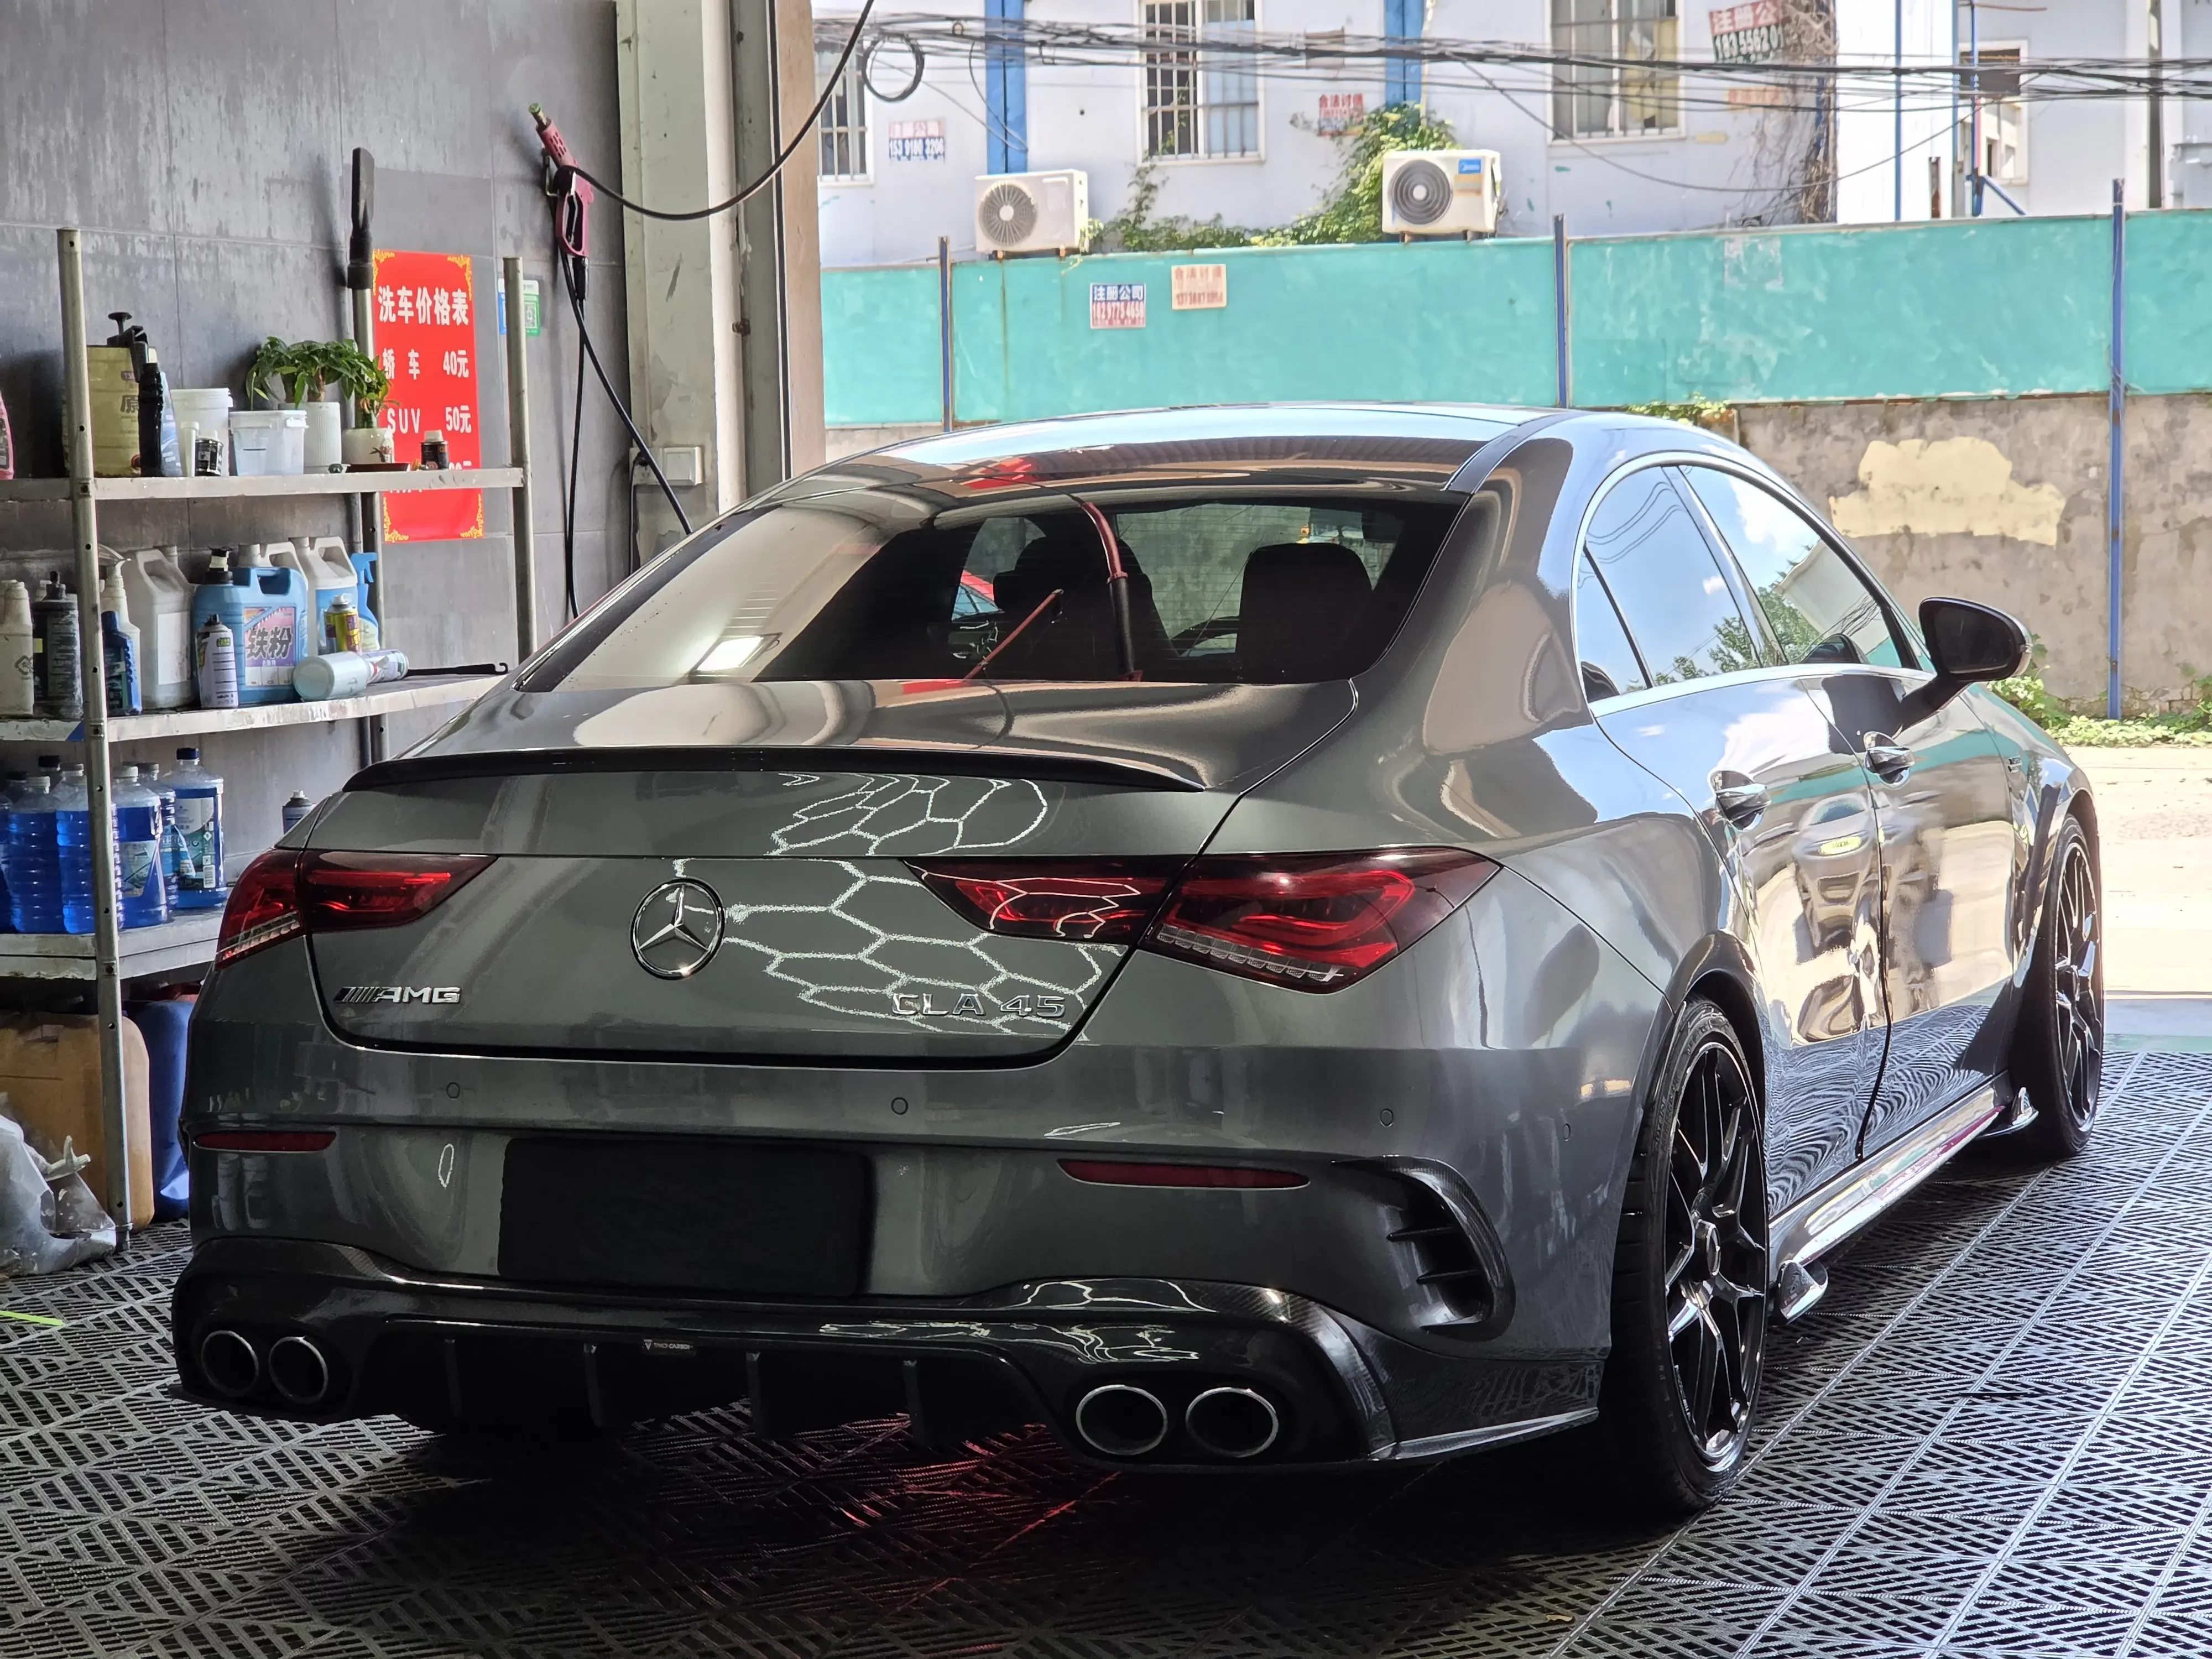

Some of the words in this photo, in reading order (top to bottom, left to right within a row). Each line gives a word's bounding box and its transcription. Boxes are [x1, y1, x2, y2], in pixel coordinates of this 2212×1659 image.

[1712, 1, 1781, 34] 注册公
[378, 285, 469, 326] 洗车价格表
[1094, 285, 1143, 301] 注册公司
[443, 349, 469, 378] 40元
[388, 408, 420, 434] SUV
[445, 405, 472, 434] 50元
[247, 627, 292, 659] 铁粉
[373, 987, 461, 1003] AMG
[892, 993, 987, 1016] CLA
[1000, 994, 1066, 1017] 45
